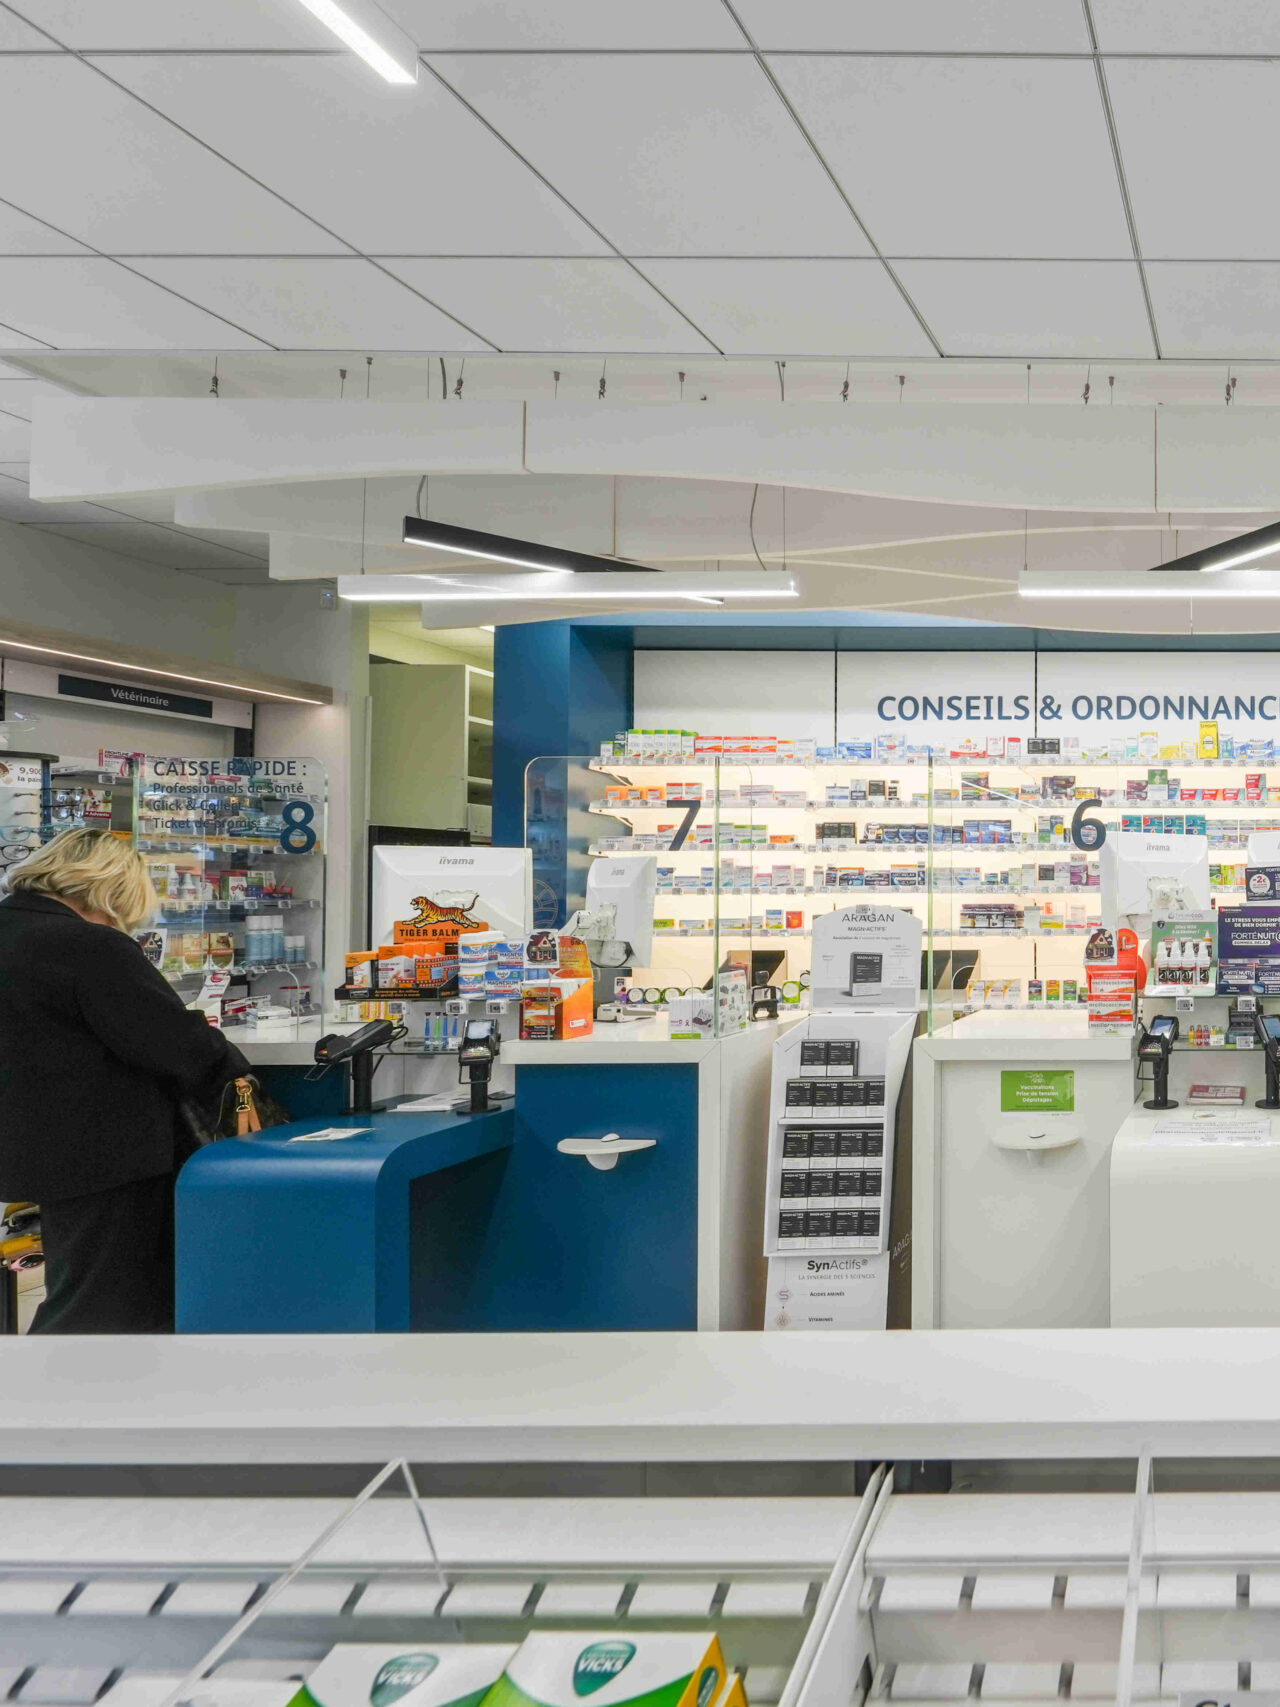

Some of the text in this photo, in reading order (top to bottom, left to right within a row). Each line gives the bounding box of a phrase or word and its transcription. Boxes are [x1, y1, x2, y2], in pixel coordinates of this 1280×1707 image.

[111, 687, 169, 707] Vétérinaire
[877, 695, 1030, 721] CONSEILS
[1040, 695, 1063, 721] &
[153, 761, 220, 776] CAISSE
[227, 761, 297, 776] RAPIDE
[153, 782, 304, 794] Professionnels de Santé
[153, 800, 182, 811] Click
[186, 801, 196, 811] &
[153, 818, 194, 829] Ticket
[280, 801, 316, 854] 8
[666, 800, 701, 850] 7
[1072, 799, 1106, 851] 6
[842, 914, 895, 922] ARAGAN
[400, 929, 459, 937] TIGER BALM
[577, 1657, 626, 1672] VICKS
[378, 1670, 425, 1685] VICKS
